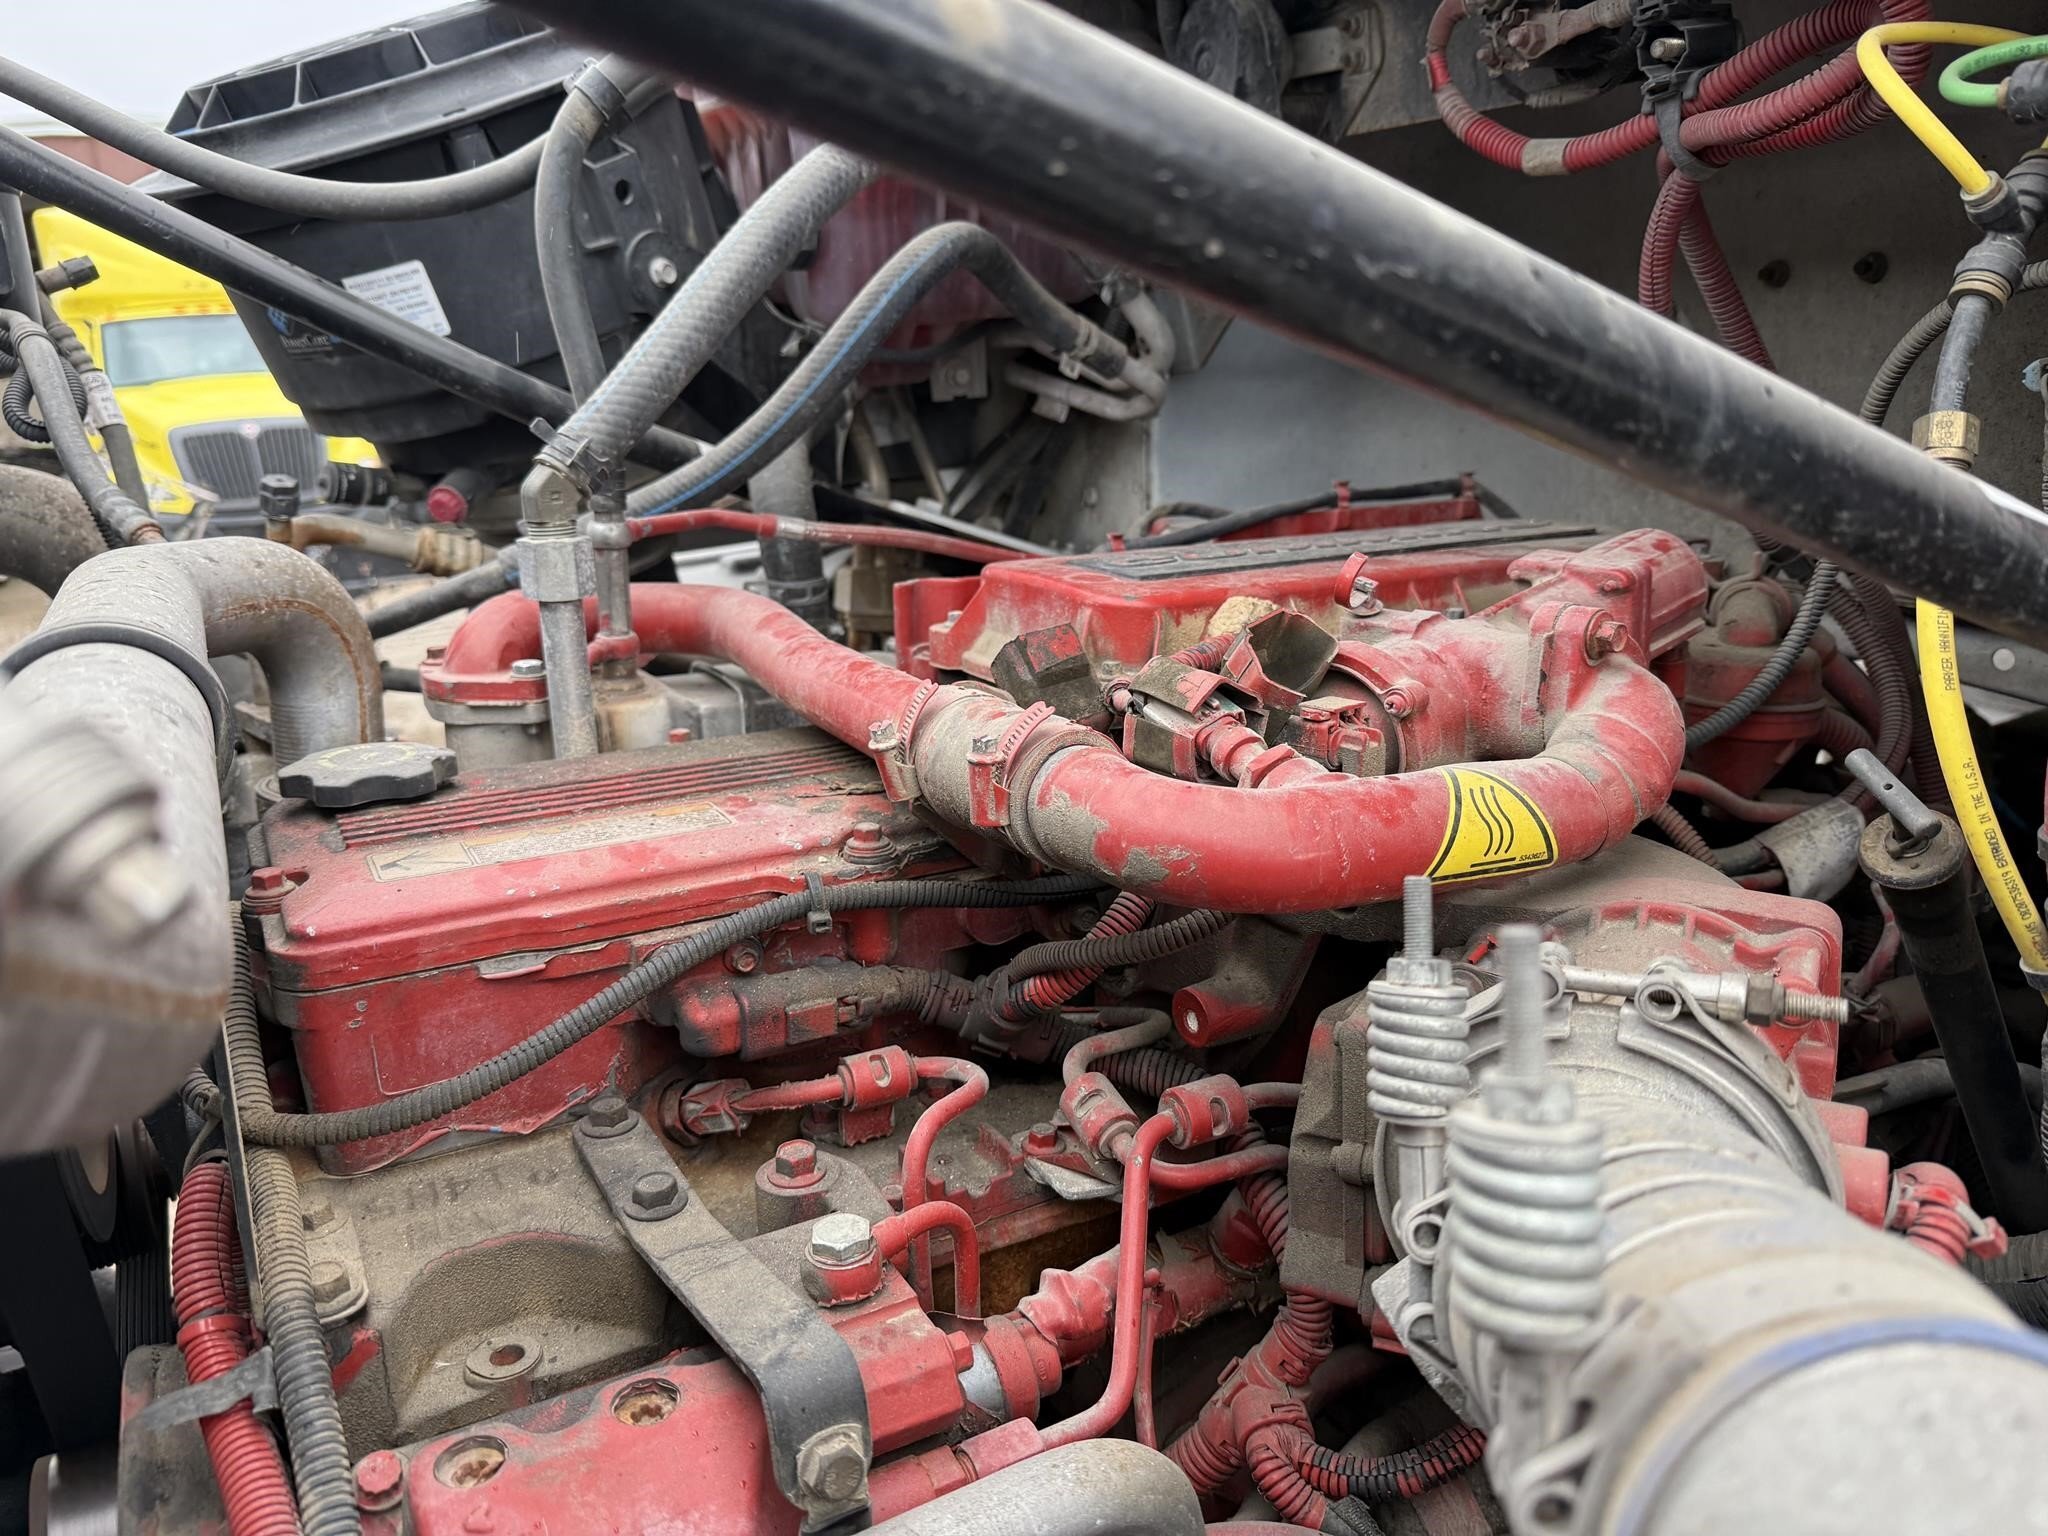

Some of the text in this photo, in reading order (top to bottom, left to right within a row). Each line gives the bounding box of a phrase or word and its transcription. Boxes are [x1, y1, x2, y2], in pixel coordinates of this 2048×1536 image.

[1941, 657, 1957, 691] PARKER
[1962, 757, 1979, 790] U.S.A.
[1971, 791, 1986, 811] THE
[1977, 811, 1992, 825] IN
[1984, 827, 2009, 869] EXTRUDED
